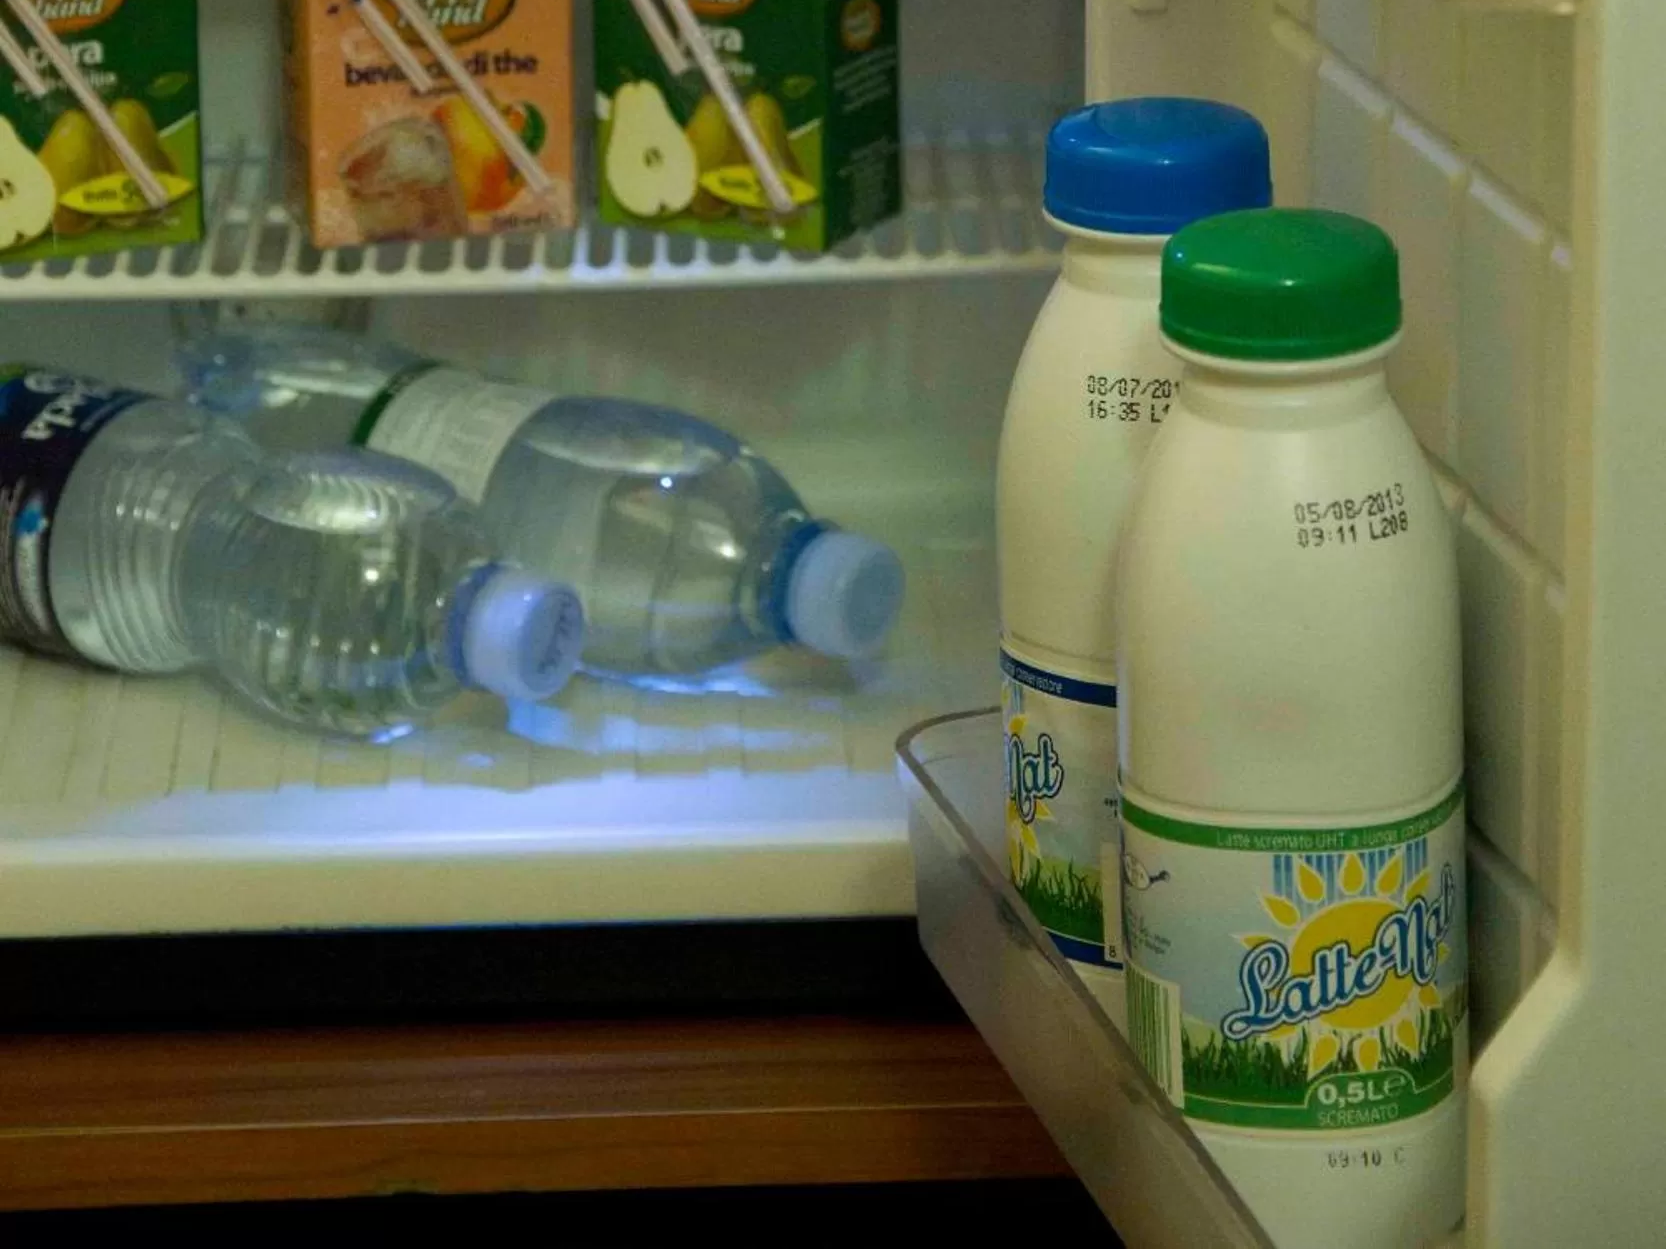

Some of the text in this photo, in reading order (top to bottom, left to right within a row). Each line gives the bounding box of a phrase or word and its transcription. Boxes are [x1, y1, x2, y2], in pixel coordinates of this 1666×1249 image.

[28, 39, 104, 70] pra
[493, 48, 539, 75] the
[1087, 375, 1179, 399] 08/07/20
[1087, 400, 1141, 422] 16:35
[1294, 482, 1405, 524] 05/08/2013
[1297, 524, 1357, 549] 09:11
[1318, 1102, 1400, 1127] SCREMATO
